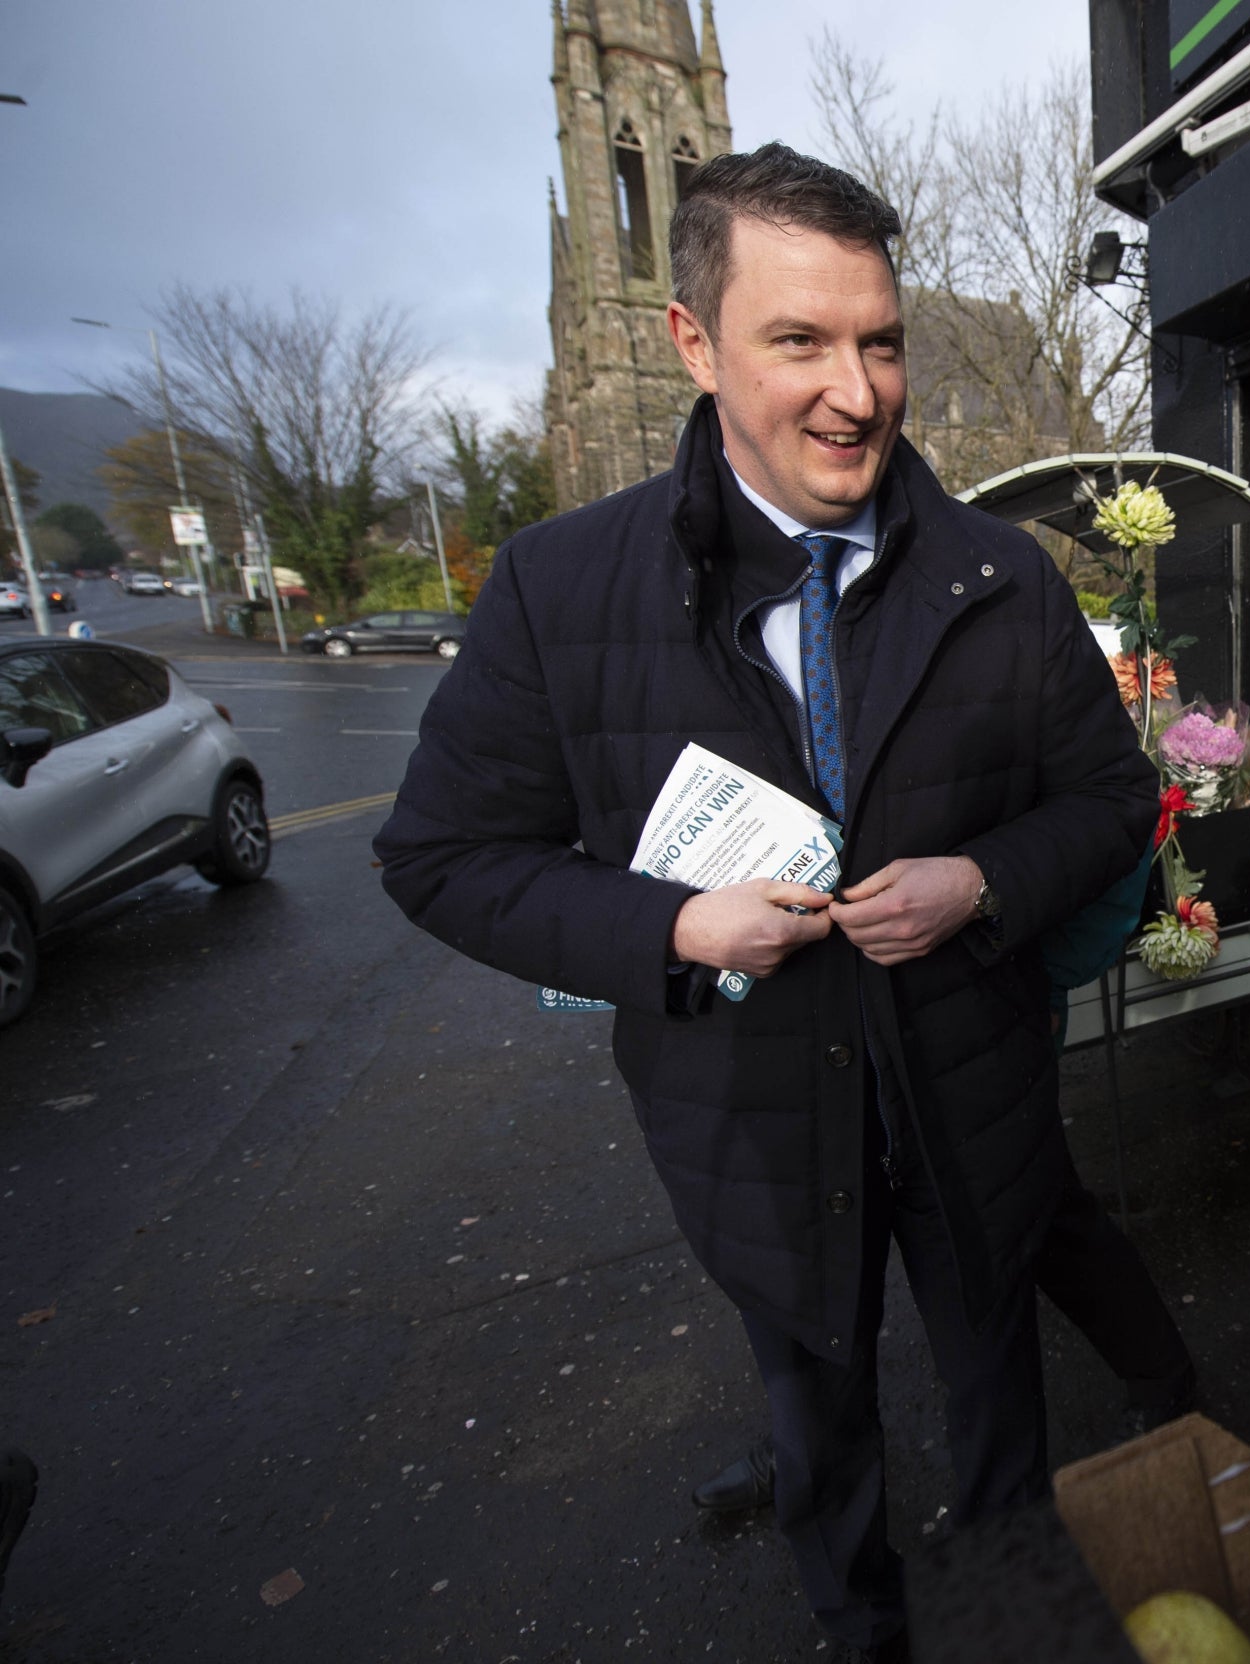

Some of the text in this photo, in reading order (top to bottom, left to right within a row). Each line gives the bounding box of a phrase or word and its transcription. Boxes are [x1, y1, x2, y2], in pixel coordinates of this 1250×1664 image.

[674, 764, 706, 804] CANDIDATE
[664, 806, 696, 844] ANTI-BREXIT
[694, 772, 729, 808] CANDIDATE
[722, 813, 736, 828] ANTI
[735, 796, 752, 814] BREXIT
[653, 844, 681, 878] WHO
[678, 810, 714, 846] CAN
[707, 778, 745, 812] WIN
[699, 851, 716, 870] separated
[739, 869, 752, 883] YOUR
[750, 858, 762, 871] VOTE
